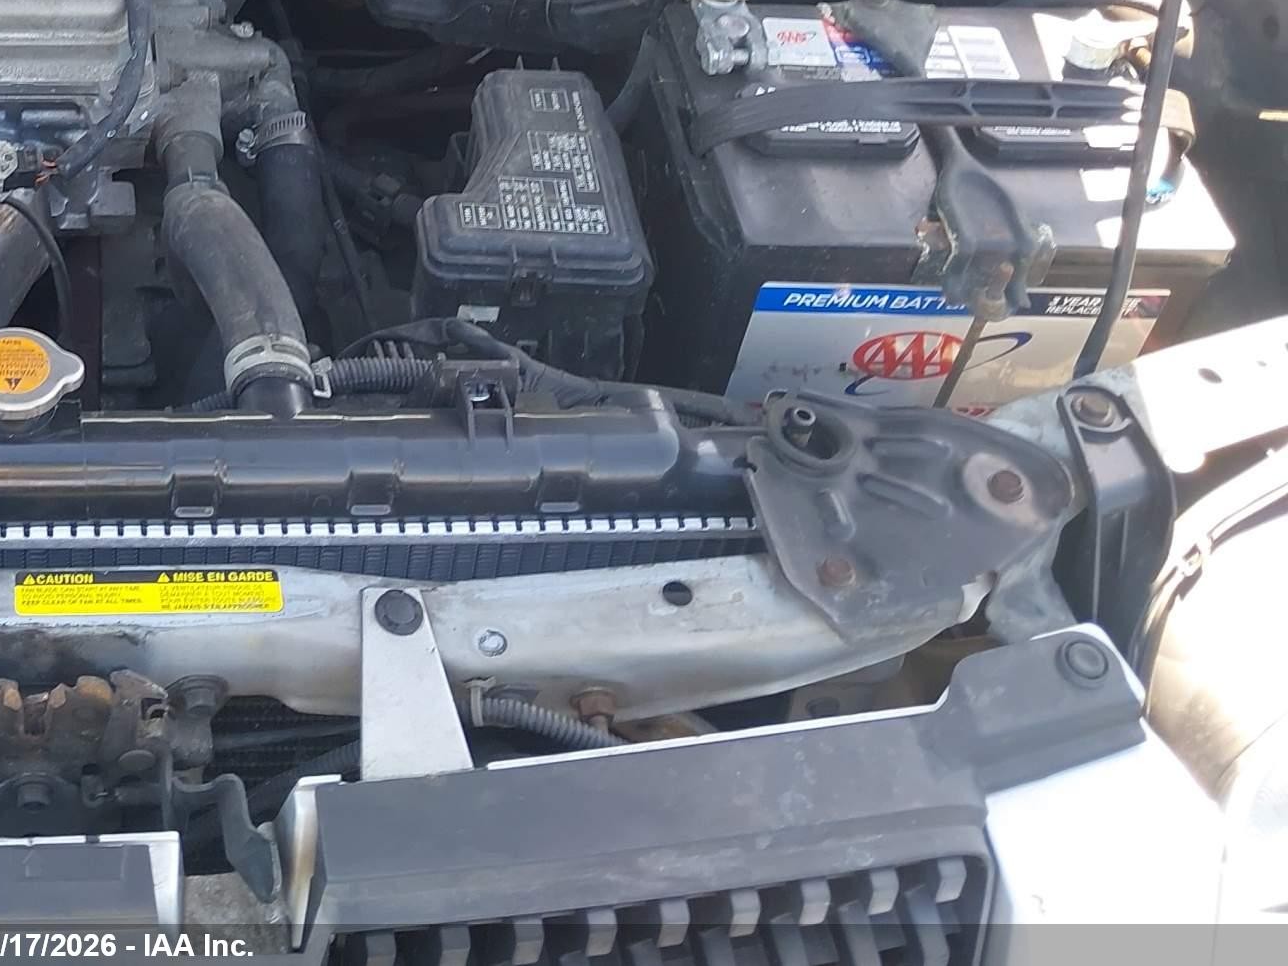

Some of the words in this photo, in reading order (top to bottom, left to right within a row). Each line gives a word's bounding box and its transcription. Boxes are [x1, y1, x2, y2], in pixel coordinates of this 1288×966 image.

[783, 292, 890, 310] PREMIUM
[1062, 296, 1102, 307] YEAR
[854, 331, 964, 380] AAA
[35, 573, 94, 585] CAUTION
[173, 572, 205, 583] MISE
[207, 572, 226, 582] EN
[227, 571, 274, 582] GARDE
